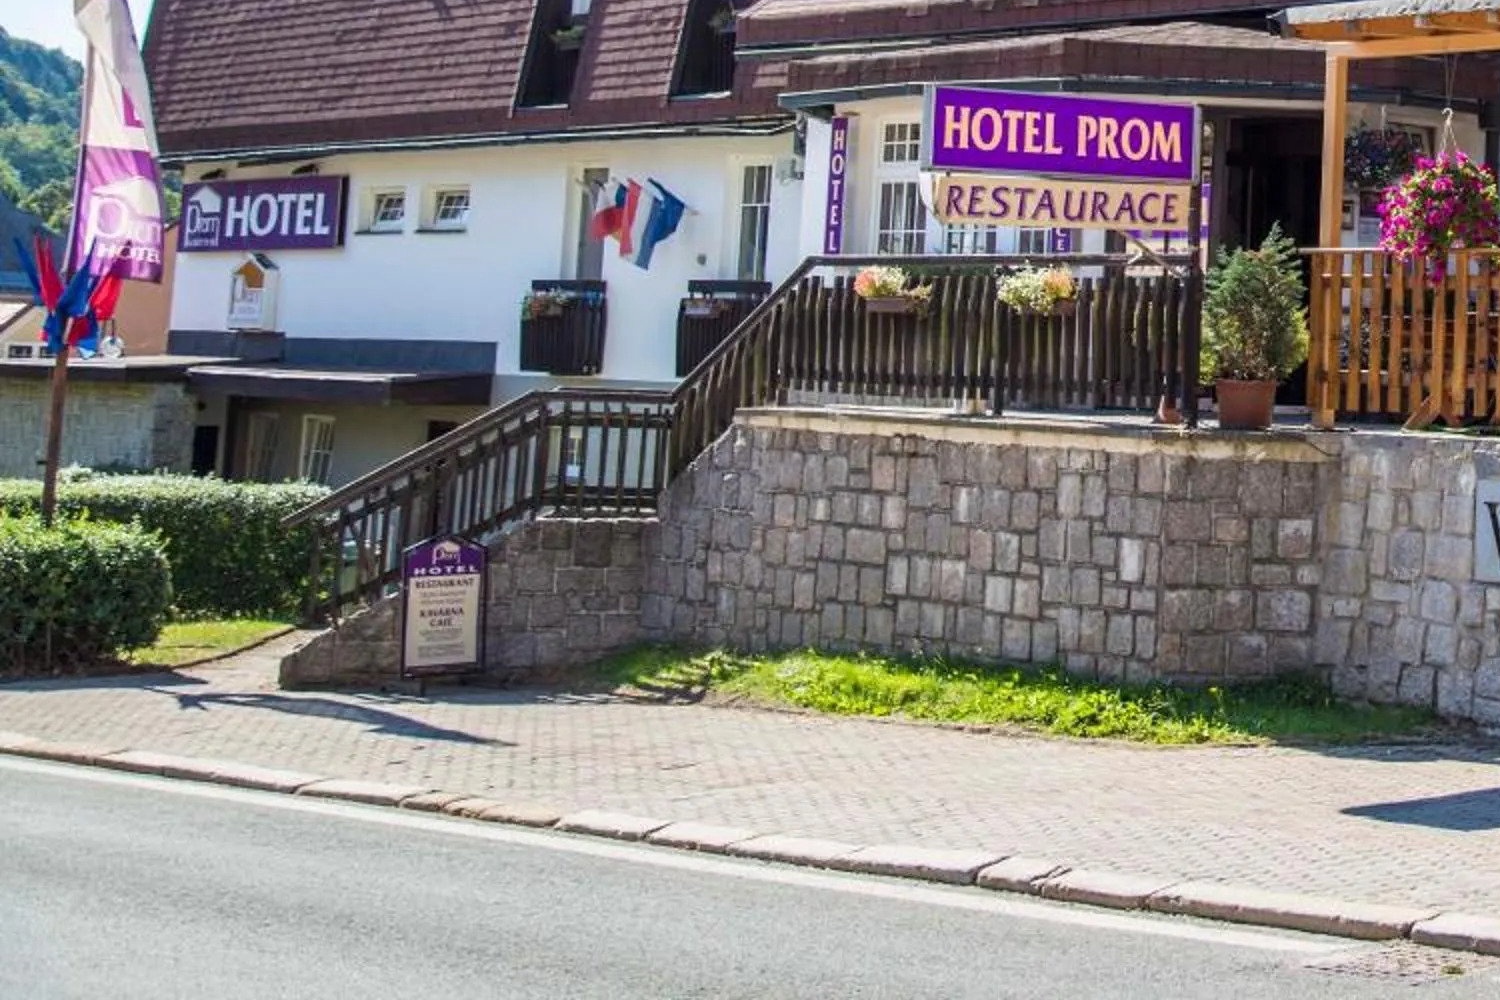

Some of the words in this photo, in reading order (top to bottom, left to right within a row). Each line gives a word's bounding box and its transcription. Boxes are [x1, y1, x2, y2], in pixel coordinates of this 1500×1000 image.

[943, 105, 1063, 155] HOTEL
[1076, 115, 1182, 163] PROM
[829, 128, 845, 252] HOTEL
[945, 185, 1179, 224] RESTAURACE
[225, 193, 329, 237] HOTEL
[413, 565, 478, 576] HOTEL
